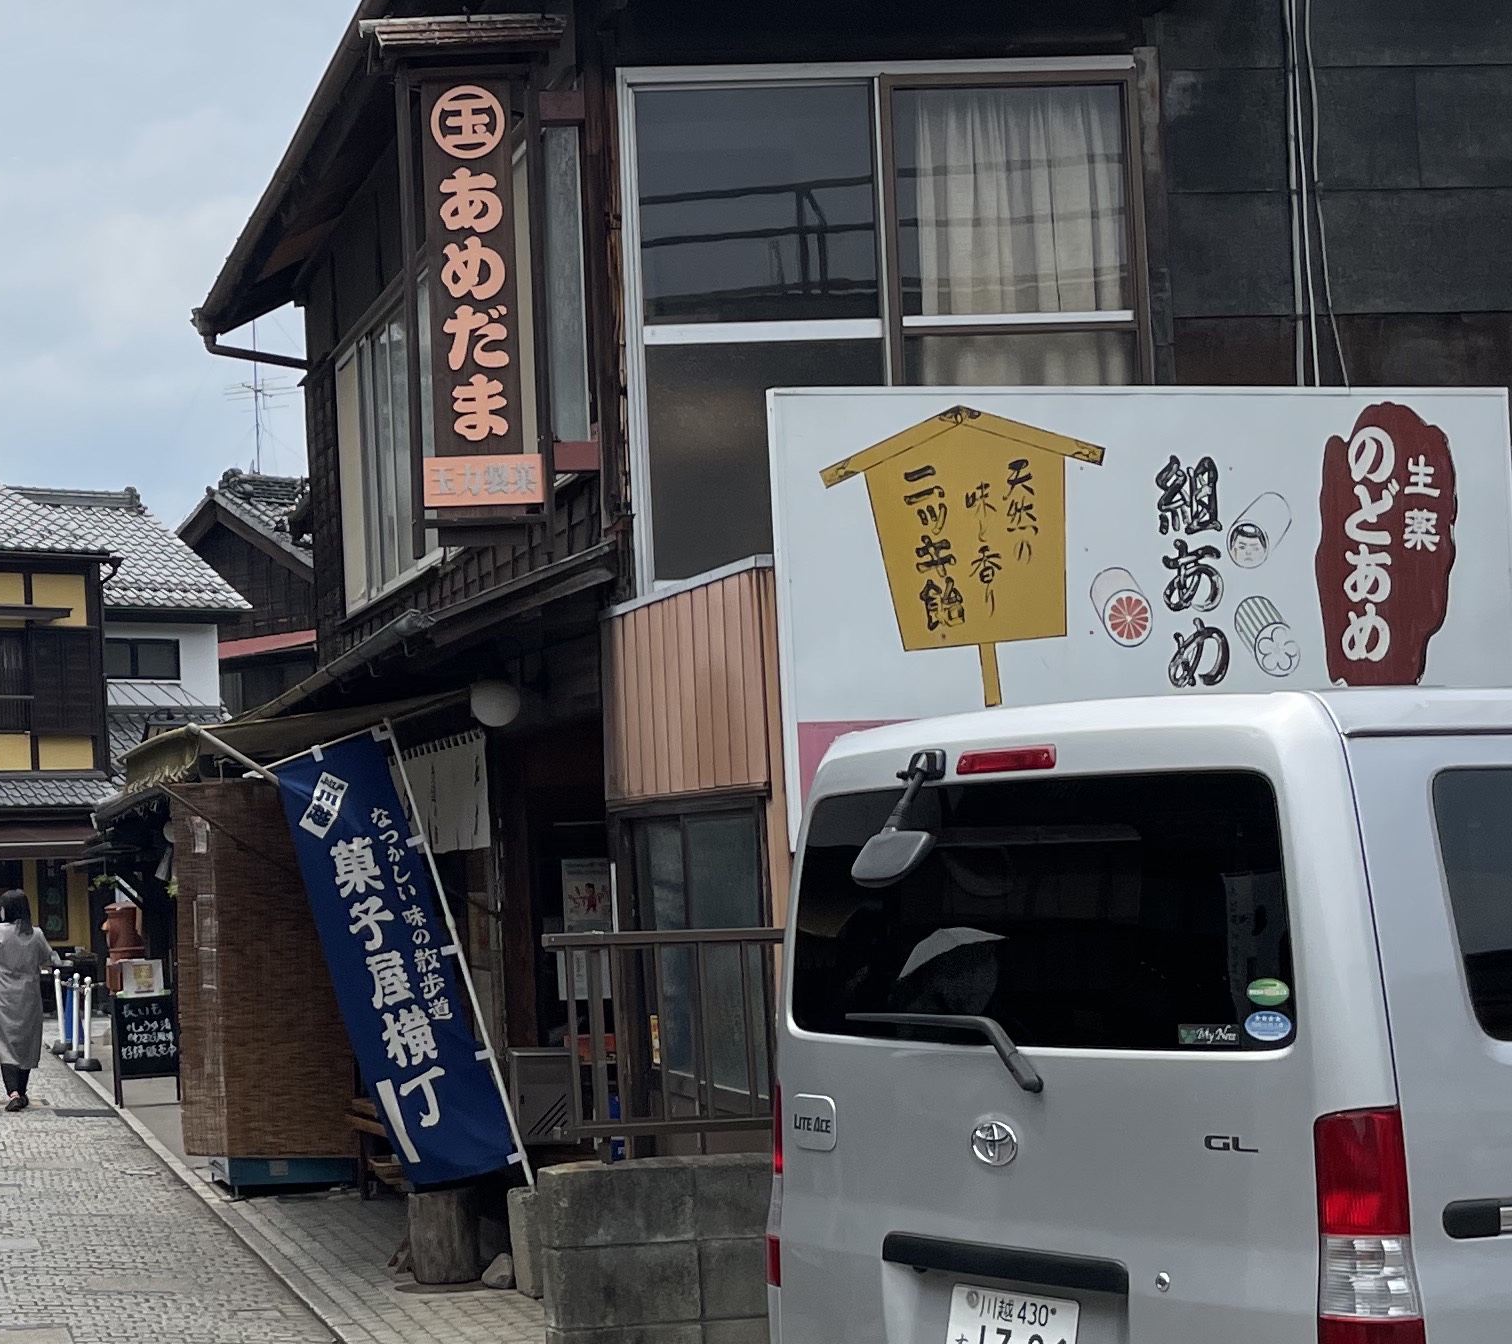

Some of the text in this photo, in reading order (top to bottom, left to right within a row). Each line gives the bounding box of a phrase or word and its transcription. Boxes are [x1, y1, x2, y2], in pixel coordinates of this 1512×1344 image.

[438, 166, 510, 442] あめだま
[429, 463, 537, 497] 玉力製菓
[903, 464, 966, 632] ニッキ飴
[964, 480, 1003, 619] 味と香り
[1002, 458, 1040, 565] 天然の
[1340, 425, 1398, 664] のどあめ
[1402, 454, 1441, 553] 生薬
[1154, 454, 1232, 688] 組あめ
[329, 834, 447, 1128] 菓子屋横丁
[369, 806, 453, 1022] なつかしい味の散歩道
[1203, 1134, 1258, 1153] GL
[978, 1294, 1049, 1327] 川越 430
